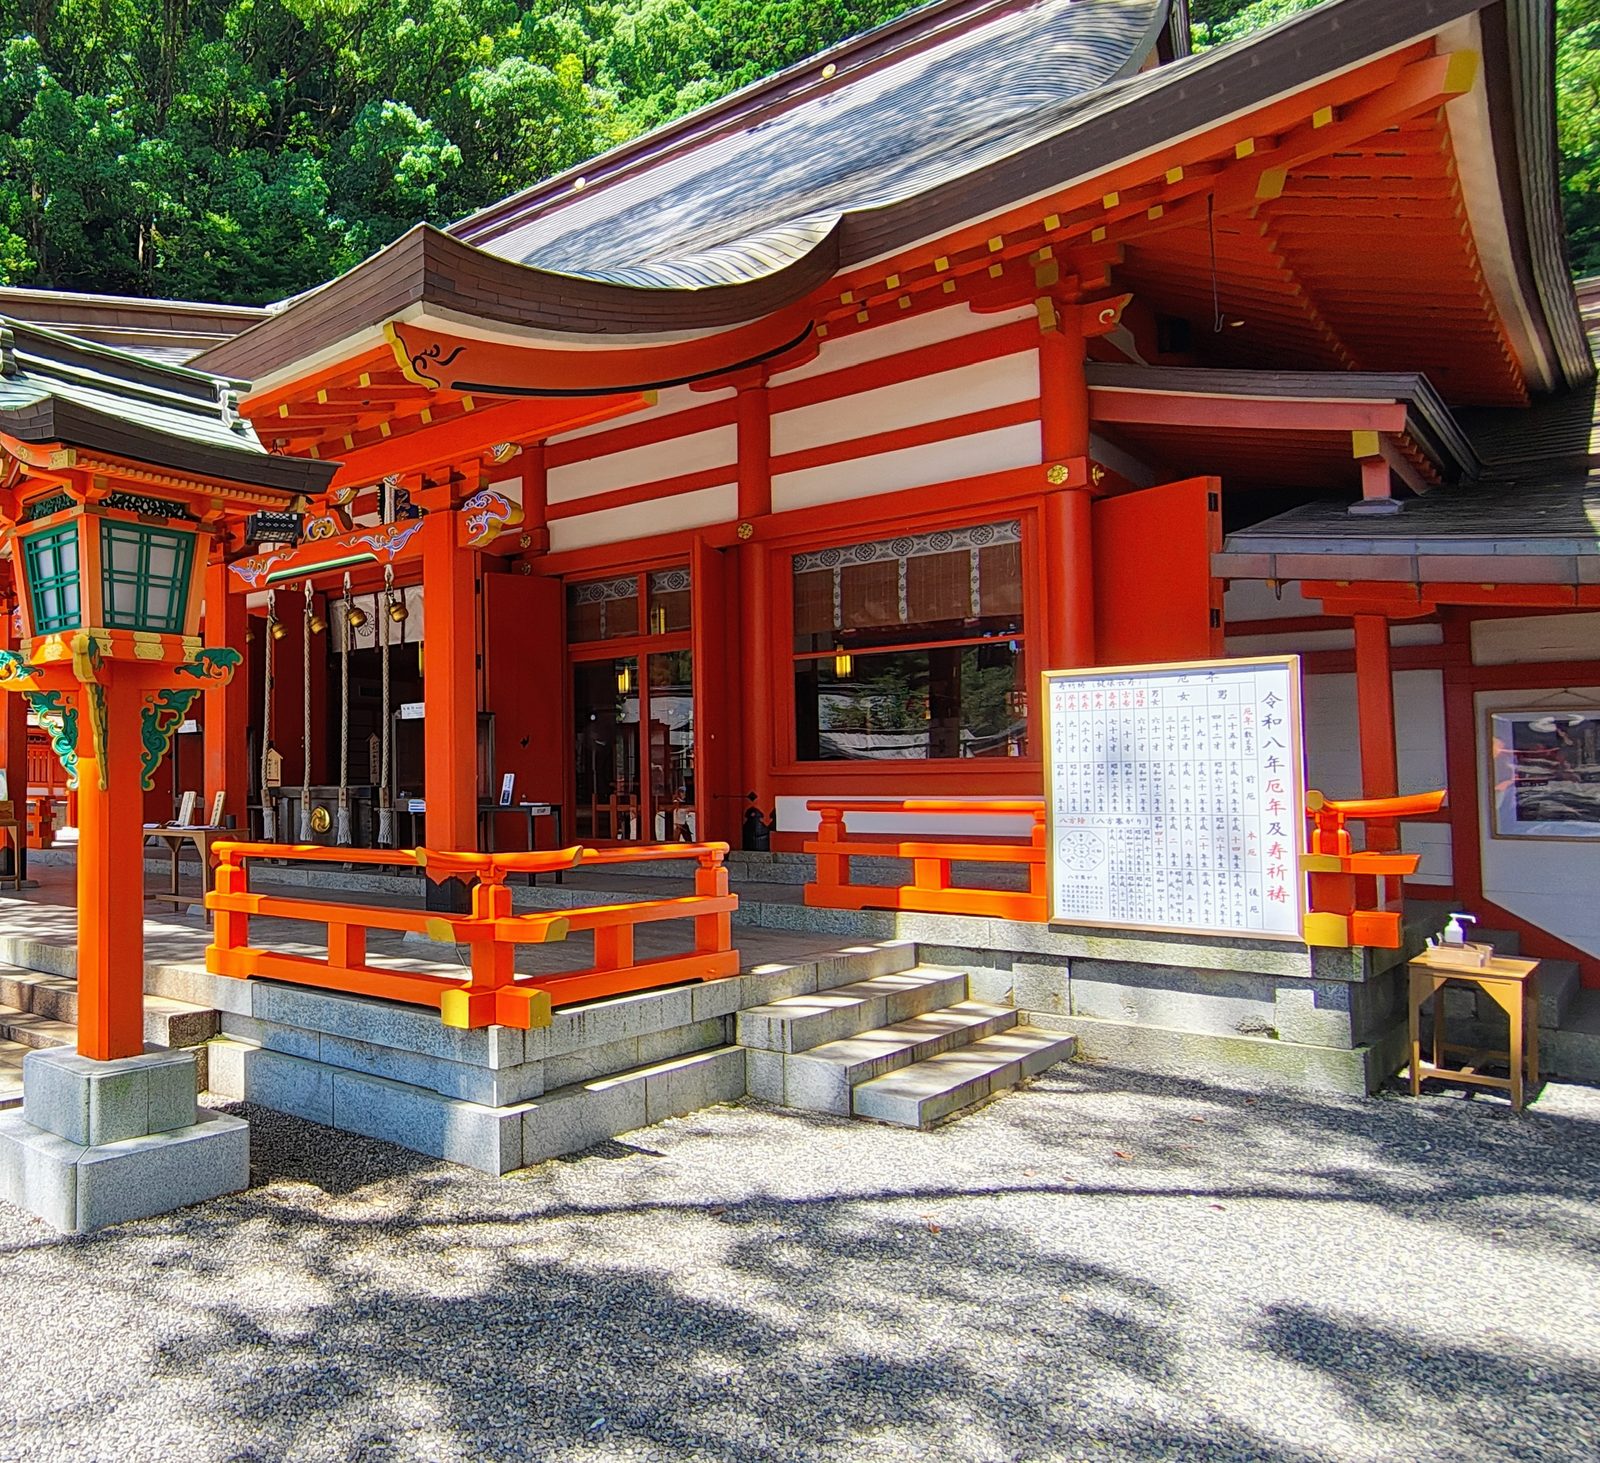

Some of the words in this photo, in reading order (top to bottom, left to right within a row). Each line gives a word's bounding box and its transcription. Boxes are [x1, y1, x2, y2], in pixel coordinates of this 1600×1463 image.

[1151, 690, 1160, 706] 男女
[1177, 691, 1190, 701] 女
[1217, 689, 1228, 700] 男
[1081, 719, 1090, 753] 八十八才
[1095, 719, 1104, 753] 八十才
[1109, 718, 1118, 752] 七十七才
[1122, 718, 1132, 752] 七十才
[1137, 717, 1147, 752] 六十一才
[1151, 717, 1161, 751] 六十一才
[1195, 715, 1206, 750] 十九才
[1211, 714, 1222, 750] 四十二才
[1227, 714, 1238, 749] 二十五才
[1261, 691, 1290, 904] 令和八年厄年及寿祈祷
